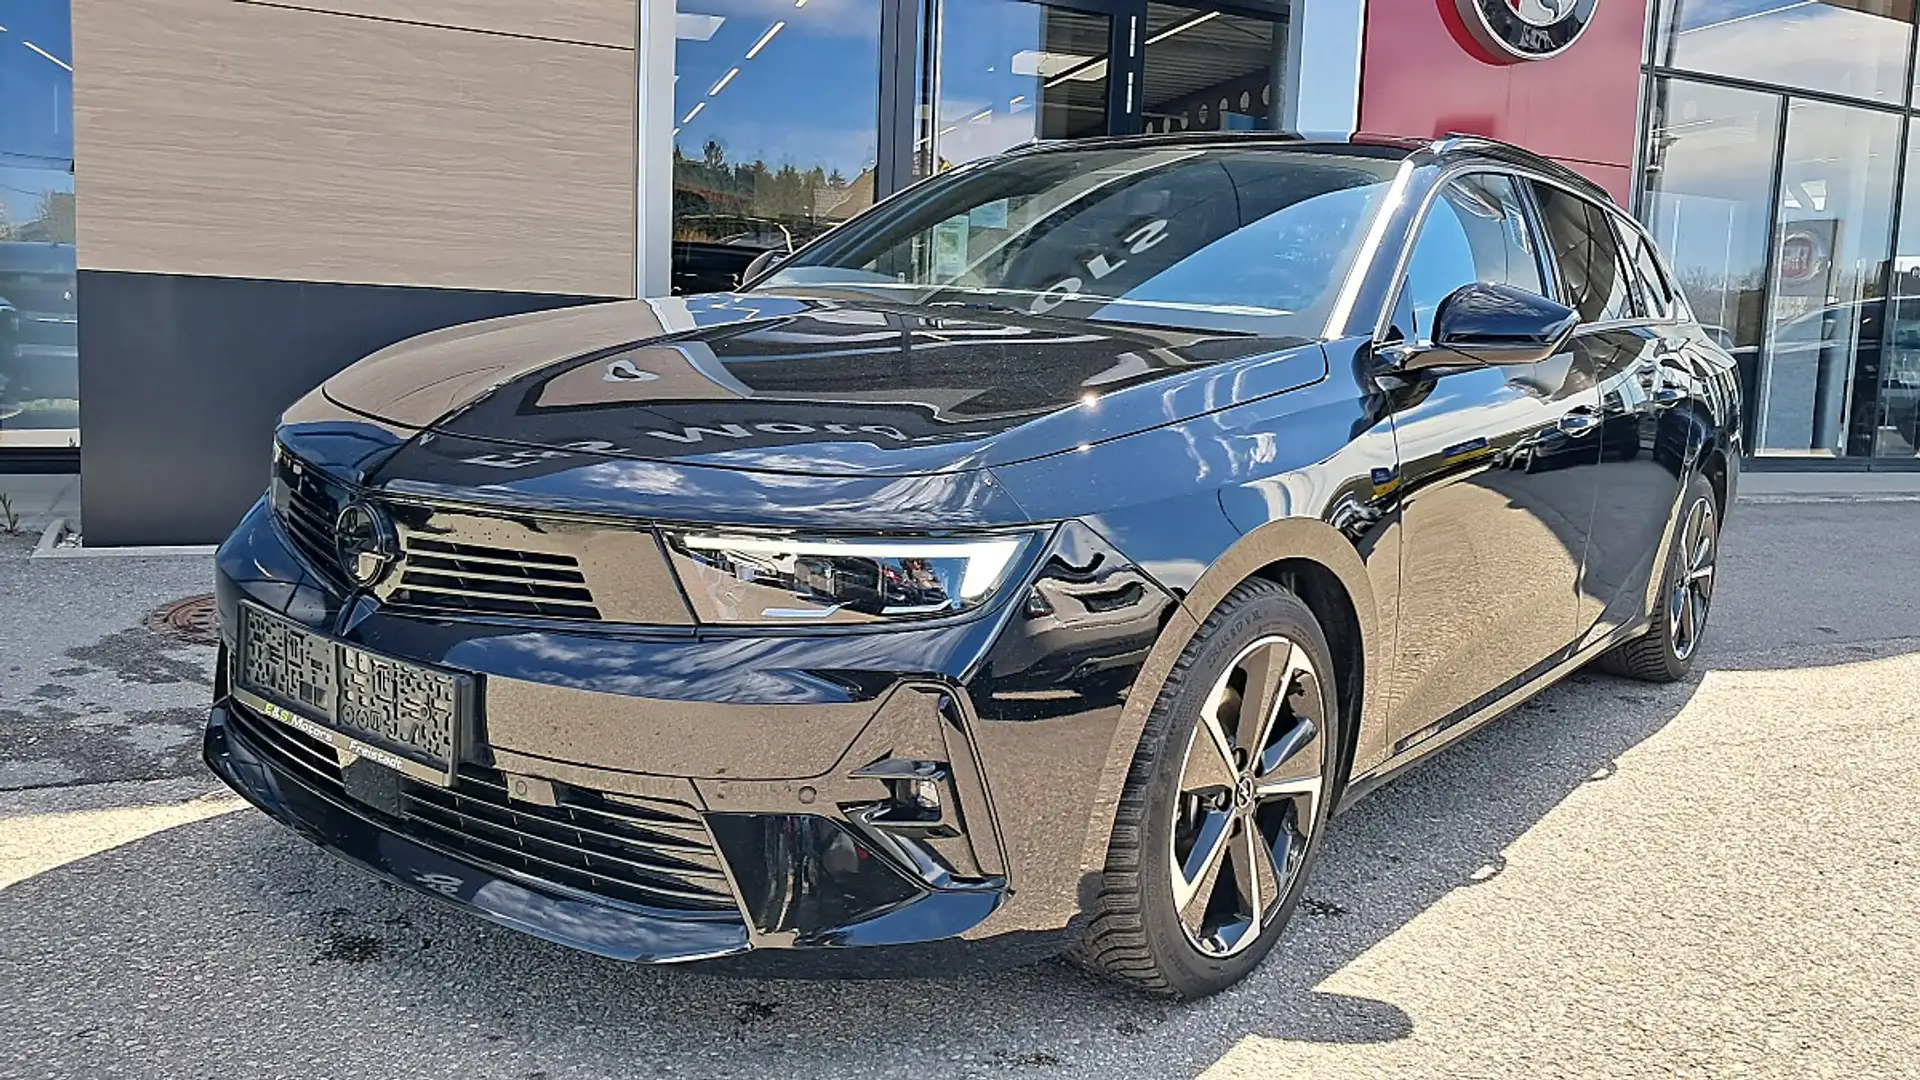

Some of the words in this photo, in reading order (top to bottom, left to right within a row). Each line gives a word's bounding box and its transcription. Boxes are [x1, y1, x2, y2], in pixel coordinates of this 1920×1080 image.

[264, 702, 290, 722] E&S
[290, 713, 333, 743] Motors
[349, 741, 404, 769] Freistadt
